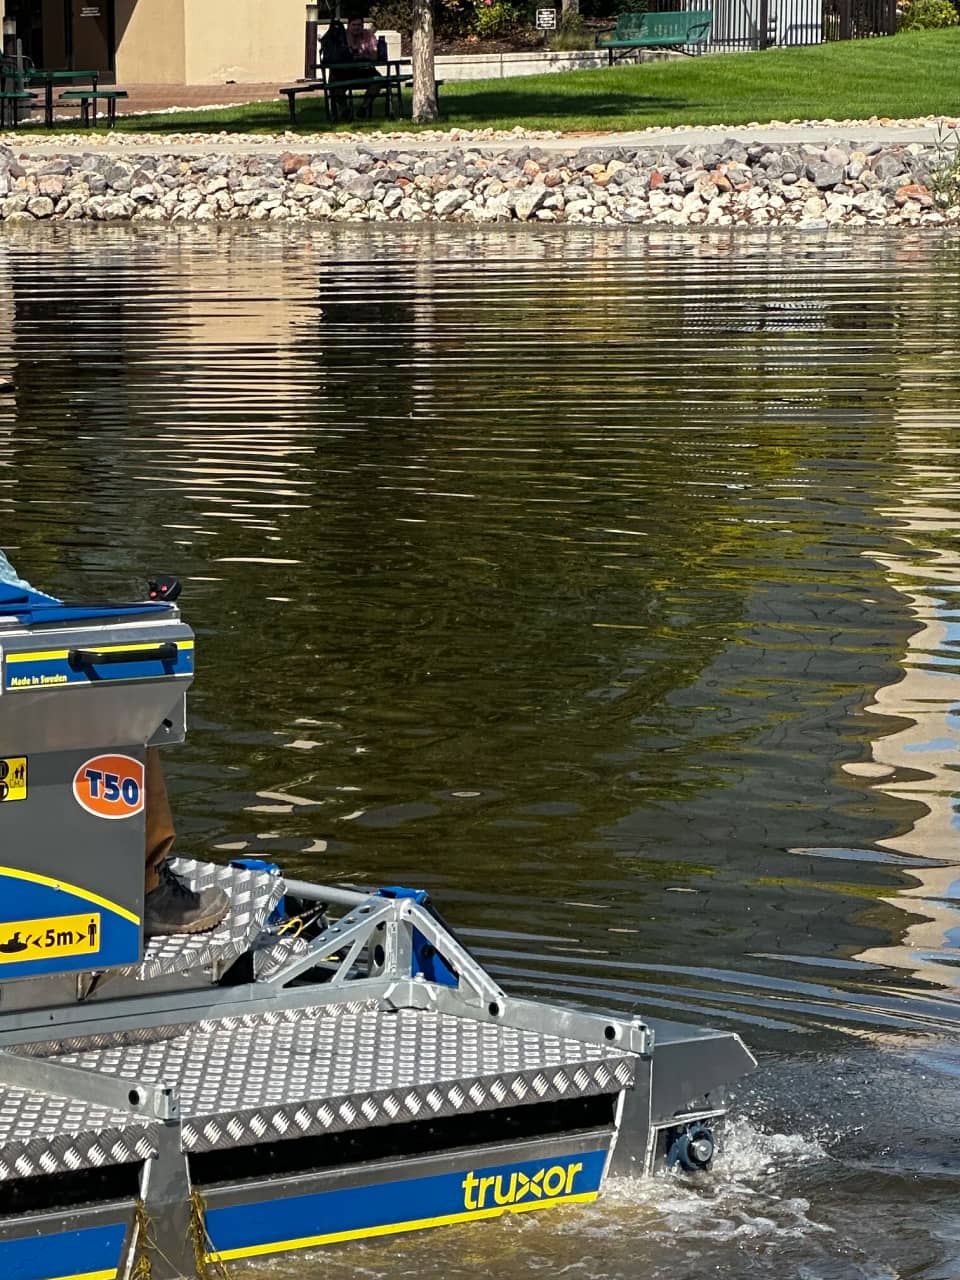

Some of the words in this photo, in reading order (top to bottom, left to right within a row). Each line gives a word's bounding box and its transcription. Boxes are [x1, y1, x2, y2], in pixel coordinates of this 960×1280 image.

[11, 676, 31, 686] Made
[32, 675, 39, 684] in
[40, 674, 67, 684] Sweden
[84, 767, 140, 807] T50
[462, 1162, 583, 1210] truxor
